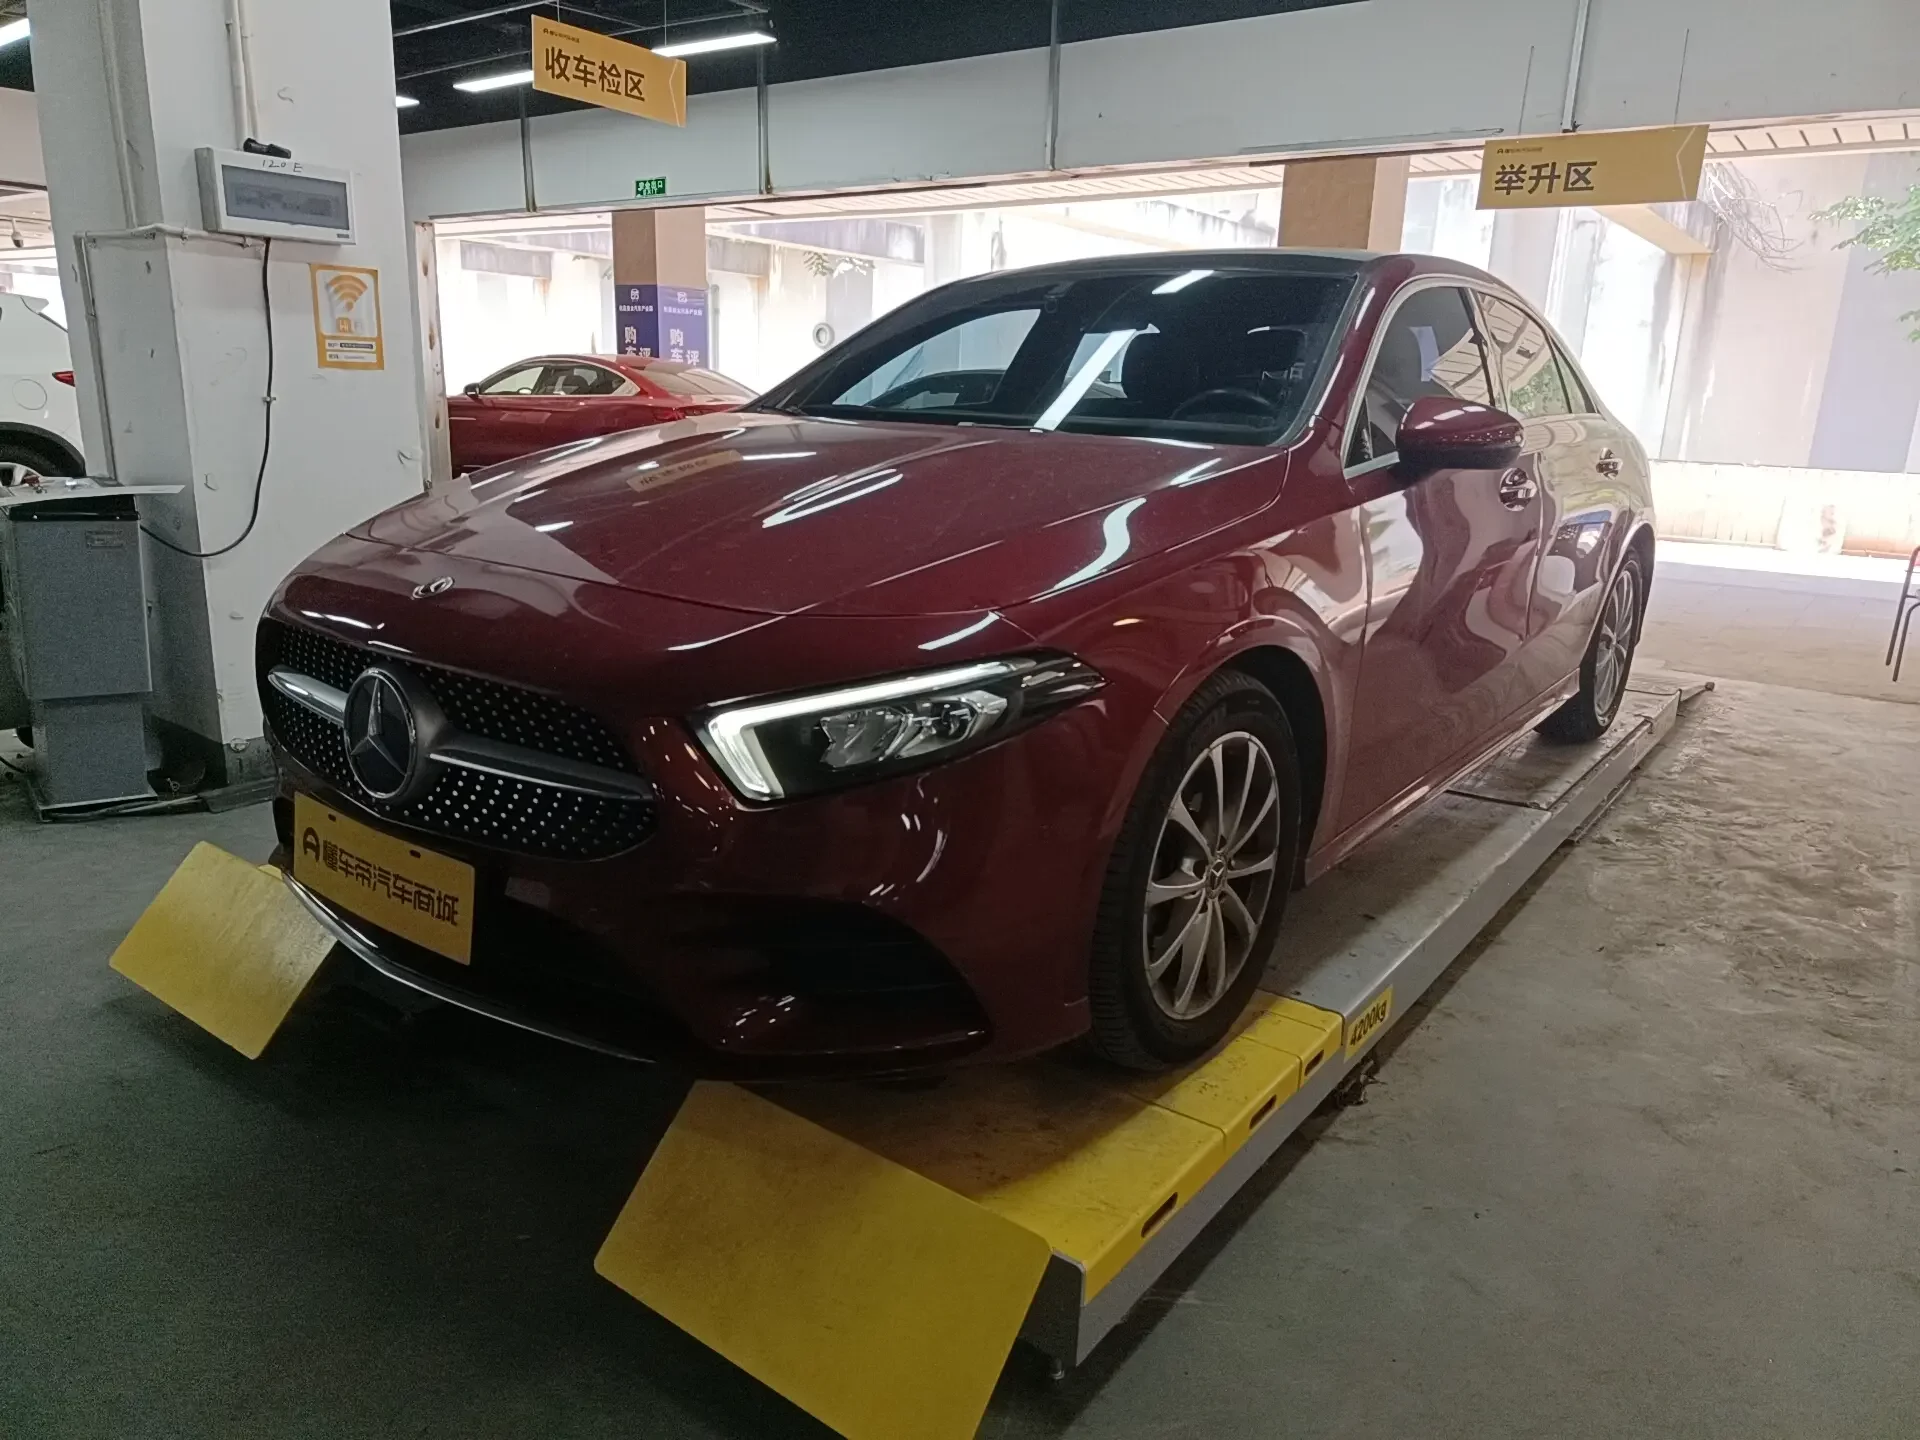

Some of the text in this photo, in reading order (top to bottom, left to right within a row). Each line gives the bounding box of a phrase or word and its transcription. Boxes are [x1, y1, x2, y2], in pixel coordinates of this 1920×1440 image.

[545, 46, 645, 102] 收车检区
[1494, 160, 1598, 196] 举升区
[323, 839, 459, 926] 懂车帝汽车商城
[1350, 999, 1388, 1047] 4200kg
